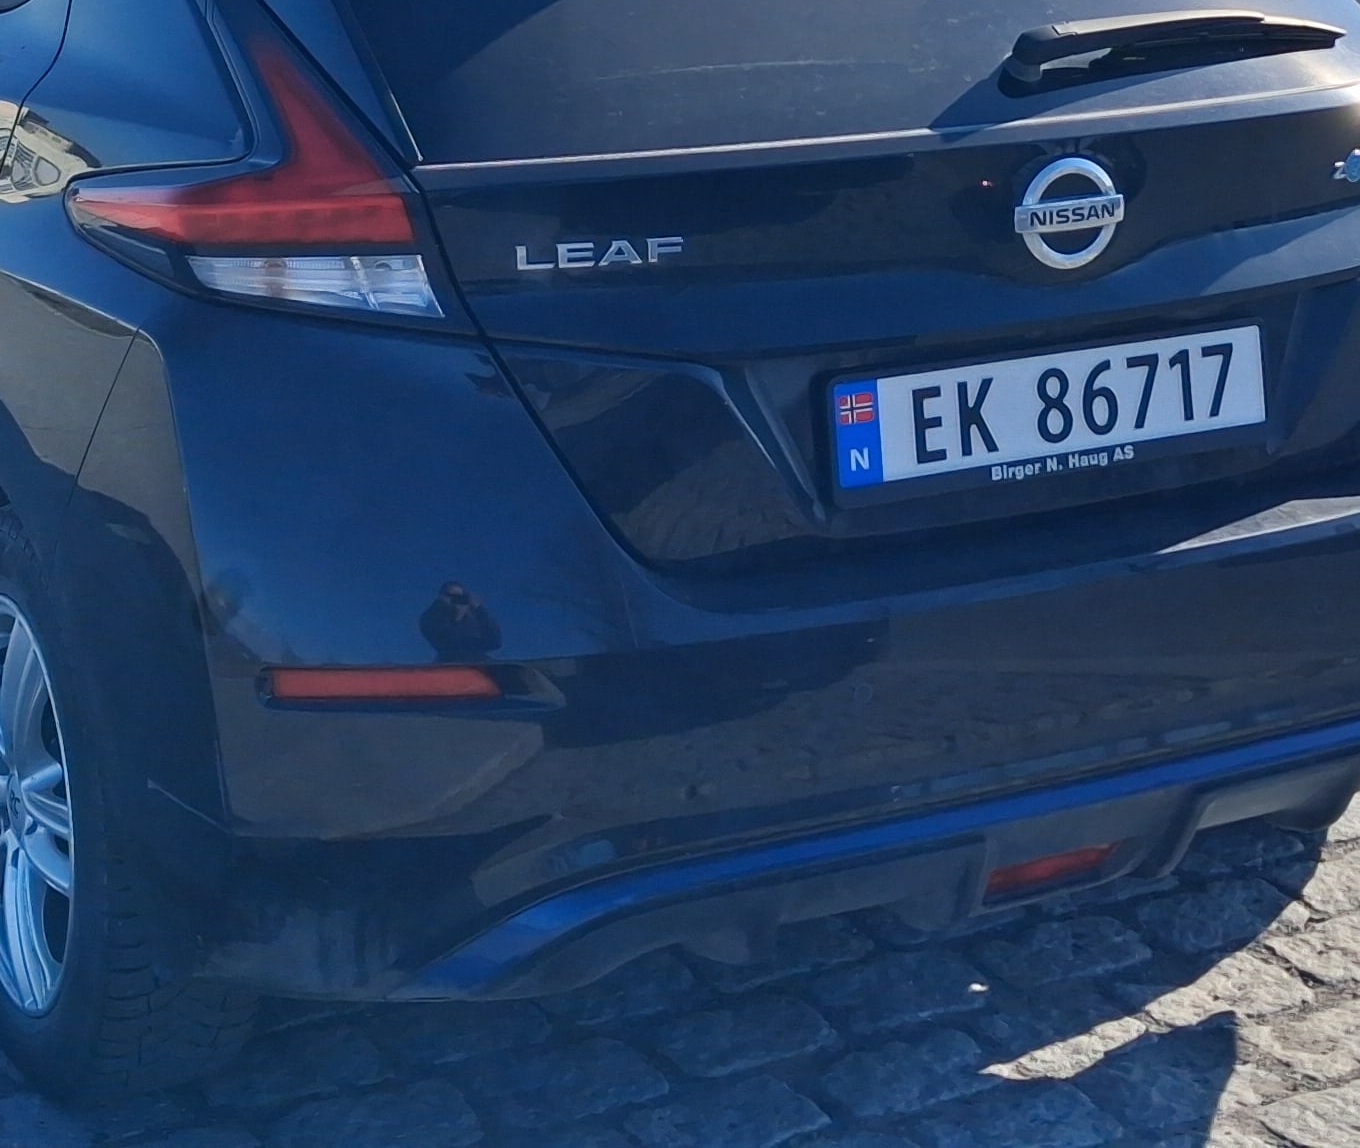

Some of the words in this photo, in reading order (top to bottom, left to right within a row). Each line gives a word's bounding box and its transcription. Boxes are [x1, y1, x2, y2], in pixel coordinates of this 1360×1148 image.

[1030, 203, 1116, 227] NISSAN
[515, 236, 684, 271] LEAF
[911, 377, 1000, 465] EK
[1036, 342, 1234, 445] 86717
[849, 447, 871, 472] N
[991, 462, 1042, 481] Birger
[1046, 456, 1063, 472] N.
[1068, 451, 1109, 467] Haug
[1113, 444, 1135, 462] AS
